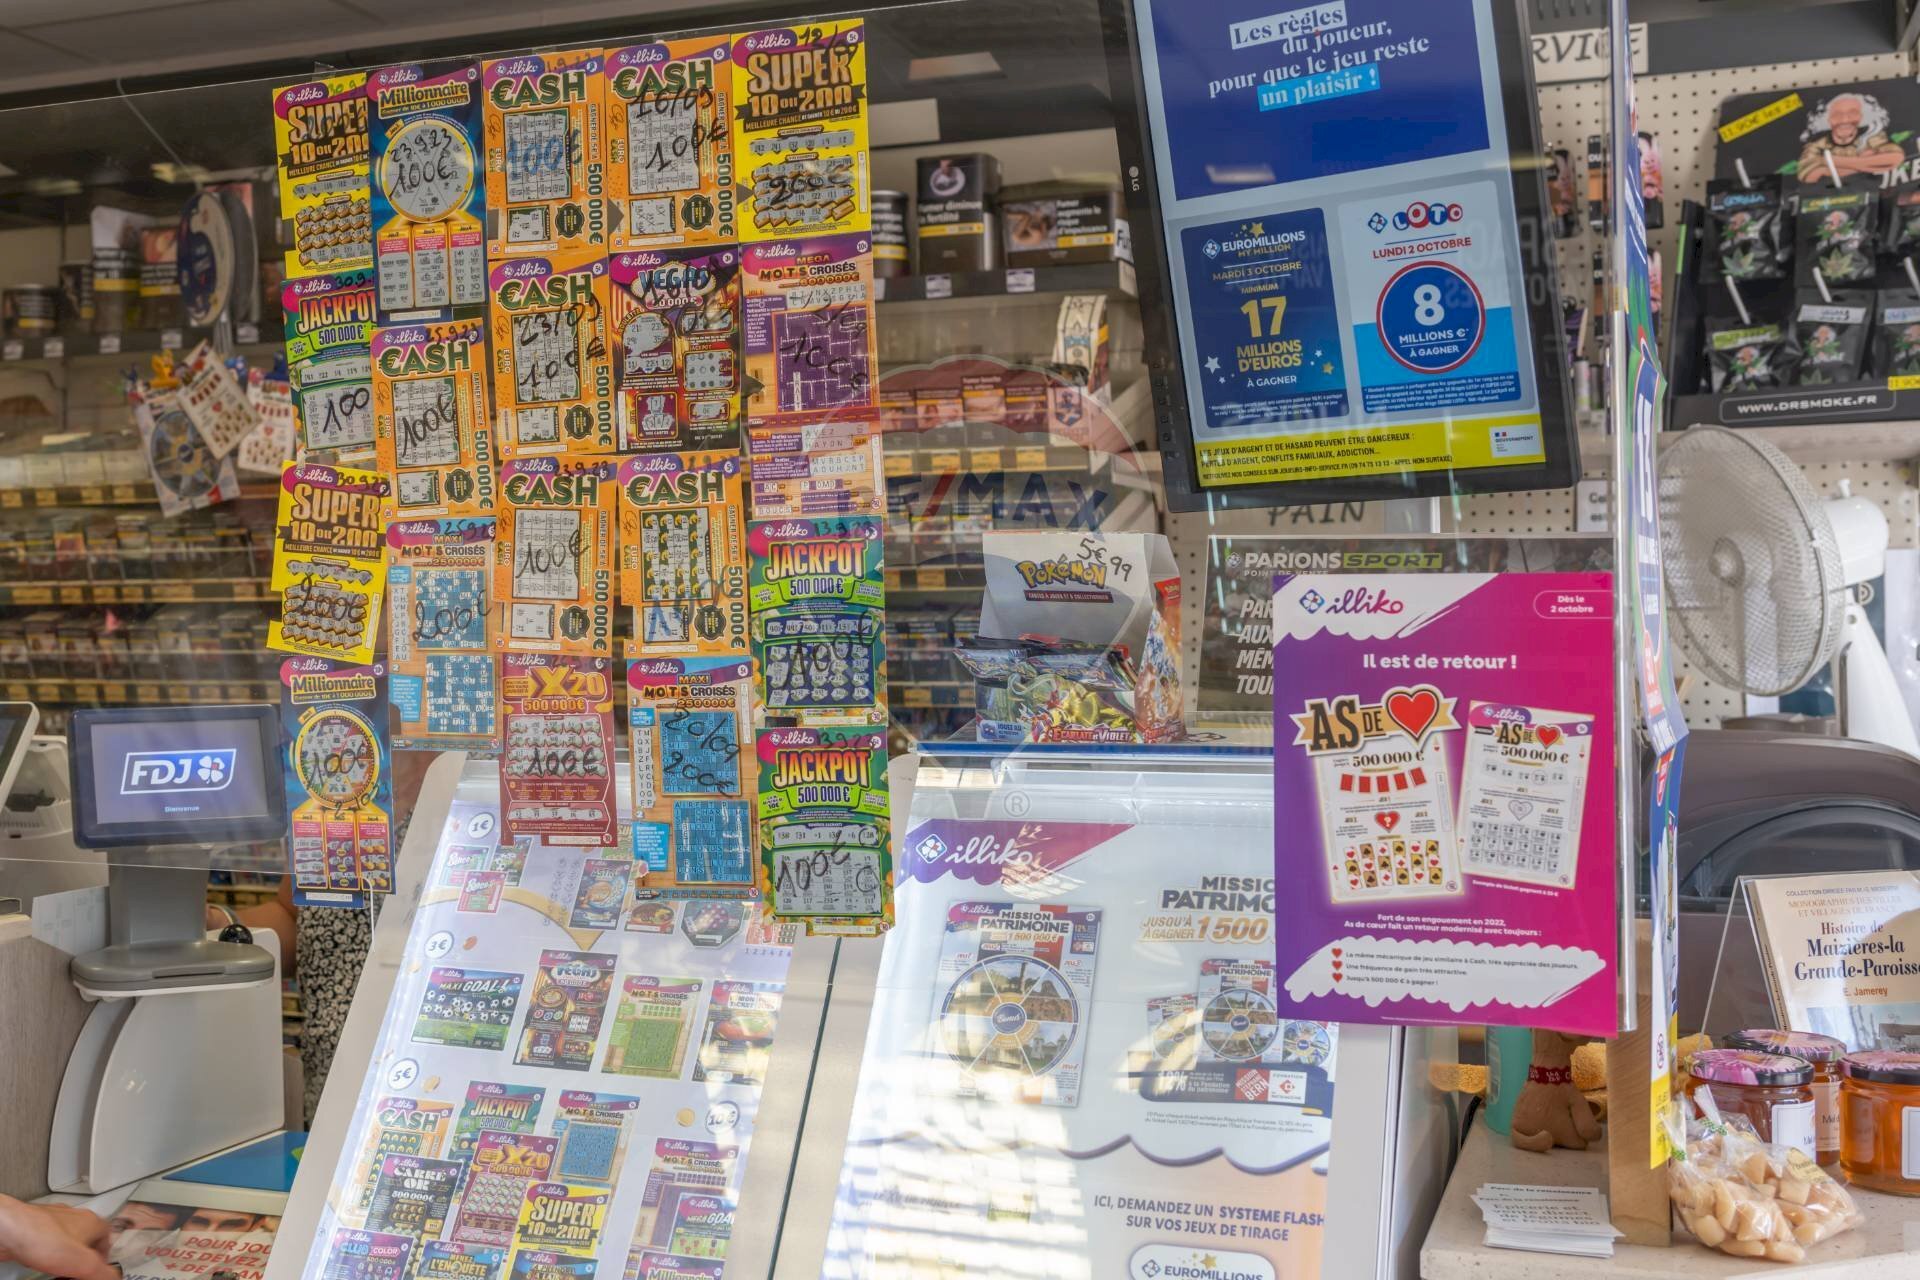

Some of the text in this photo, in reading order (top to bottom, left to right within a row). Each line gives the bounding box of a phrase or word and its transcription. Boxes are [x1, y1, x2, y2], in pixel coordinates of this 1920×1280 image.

[1234, 9, 1343, 45] Les règles
[757, 34, 791, 49] illiko
[1283, 20, 1392, 55] du joueur,
[1208, 37, 1429, 98] pour que le jeu reste
[1261, 91, 1288, 107] un
[1295, 72, 1362, 105] plaisir
[1131, 178, 1139, 192] LG
[945, 200, 983, 211] diminue
[1392, 201, 1463, 231] LOTO
[1222, 231, 1305, 252] EUROMILLIONS
[1372, 237, 1472, 259] LUNDI 2 OCTOBRE
[1238, 244, 1291, 257] MY MILLION
[1212, 261, 1302, 281] MARDI 3 OCTOBRE
[1241, 283, 1279, 294] MINIMUM
[1413, 284, 1445, 326] 8
[1240, 296, 1287, 338] 17
[1399, 330, 1454, 344] MILLIONS
[1236, 340, 1302, 358] MILLIONS
[1410, 345, 1459, 358] À GAGNER
[1247, 375, 1297, 387] À GAGNER
[1214, 447, 1229, 455] JEUX
[1232, 445, 1263, 454] D'ARGENT
[1265, 443, 1273, 451] ET
[1285, 441, 1313, 449] HASARD
[1315, 438, 1346, 447] PEUVENT
[1367, 432, 1410, 442] DANGEREUX
[1495, 435, 1534, 443] GOUVERNEMENT
[1262, 453, 1295, 463] CONFLITS
[304, 470, 333, 483] illiko
[293, 483, 380, 529] SUPER
[291, 520, 314, 542] 10
[332, 526, 378, 548] 200
[766, 541, 866, 580] JACKPOT
[1244, 553, 1440, 568] PARIONS SPORT
[790, 579, 811, 595] 500
[812, 577, 834, 594] 000
[1326, 587, 1404, 614] illiko
[1557, 595, 1584, 603] Dès le
[1551, 604, 1594, 613] 2 octobre
[1363, 654, 1376, 669] Il
[1380, 656, 1410, 669] est
[1413, 654, 1439, 669] de
[1442, 656, 1506, 669] retour
[292, 677, 374, 693] Millionnaire
[679, 676, 709, 684] MAXI
[690, 685, 735, 697] CROISÉS
[1309, 699, 1384, 751] AS DE
[1498, 724, 1522, 746] AS
[1353, 750, 1425, 768] 500 000 €
[130, 759, 191, 785] FDJ
[773, 750, 869, 789] JACKPOT
[164, 805, 200, 813] Bienvenue
[946, 836, 1032, 865] illiko
[1002, 912, 1050, 921] MISSION
[1143, 913, 1193, 928] JUSQU'À
[1422, 916, 1472, 926] engouement
[981, 919, 1070, 934] PATRIMOINE
[1153, 930, 1194, 940] GAGNER
[1344, 920, 1354, 928] As
[1441, 925, 1482, 933] modernisé
[1821, 920, 1884, 935] Histoire de
[1807, 935, 1904, 957] Maizières-la
[1220, 968, 1272, 977] PATRIMOINE
[1854, 986, 1888, 998] Jamerey
[1245, 1080, 1270, 1101] BERN
[471, 1098, 532, 1117] JACKPOT
[531, 1197, 596, 1226] SUPER
[1094, 1195, 1114, 1210] ICI,
[1117, 1197, 1191, 1216] DEMANDEZ
[1194, 1204, 1213, 1217] UN
[1219, 1206, 1281, 1223] SYSTEME
[1126, 1215, 1289, 1241] SUR VOS JEUX DE TIRAGE
[185, 1237, 237, 1250] POUR
[144, 1246, 260, 1266] VOUS DEVEZ
[181, 1263, 206, 1274] DE
